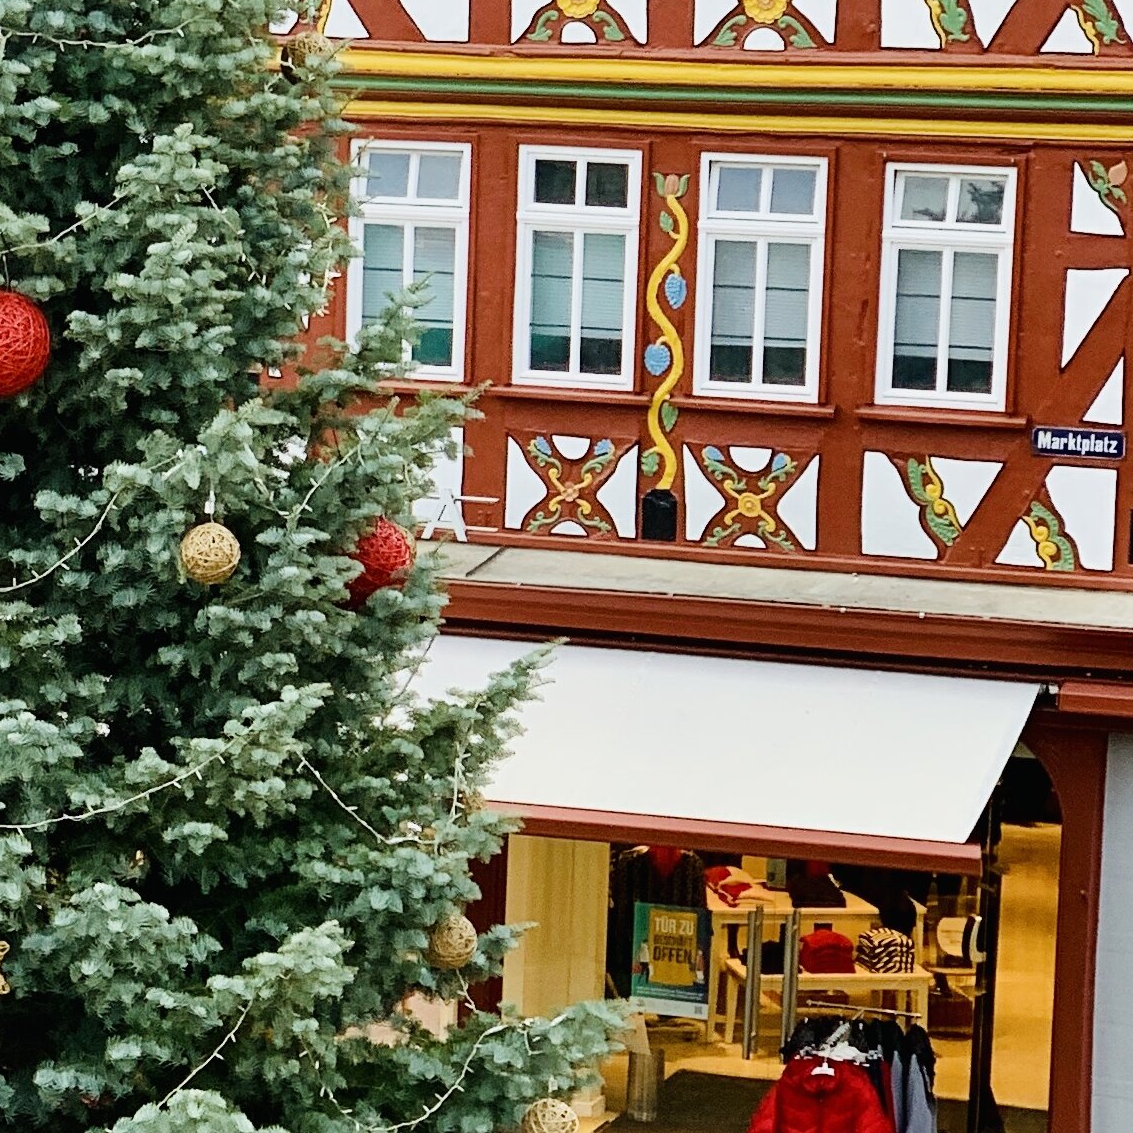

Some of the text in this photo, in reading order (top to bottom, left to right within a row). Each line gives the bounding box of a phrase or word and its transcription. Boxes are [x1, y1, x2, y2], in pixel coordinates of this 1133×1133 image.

[1037, 430, 1118, 456] Marktplatz
[654, 915, 694, 935] TÜR ZU
[653, 945, 692, 965] OFFEN
